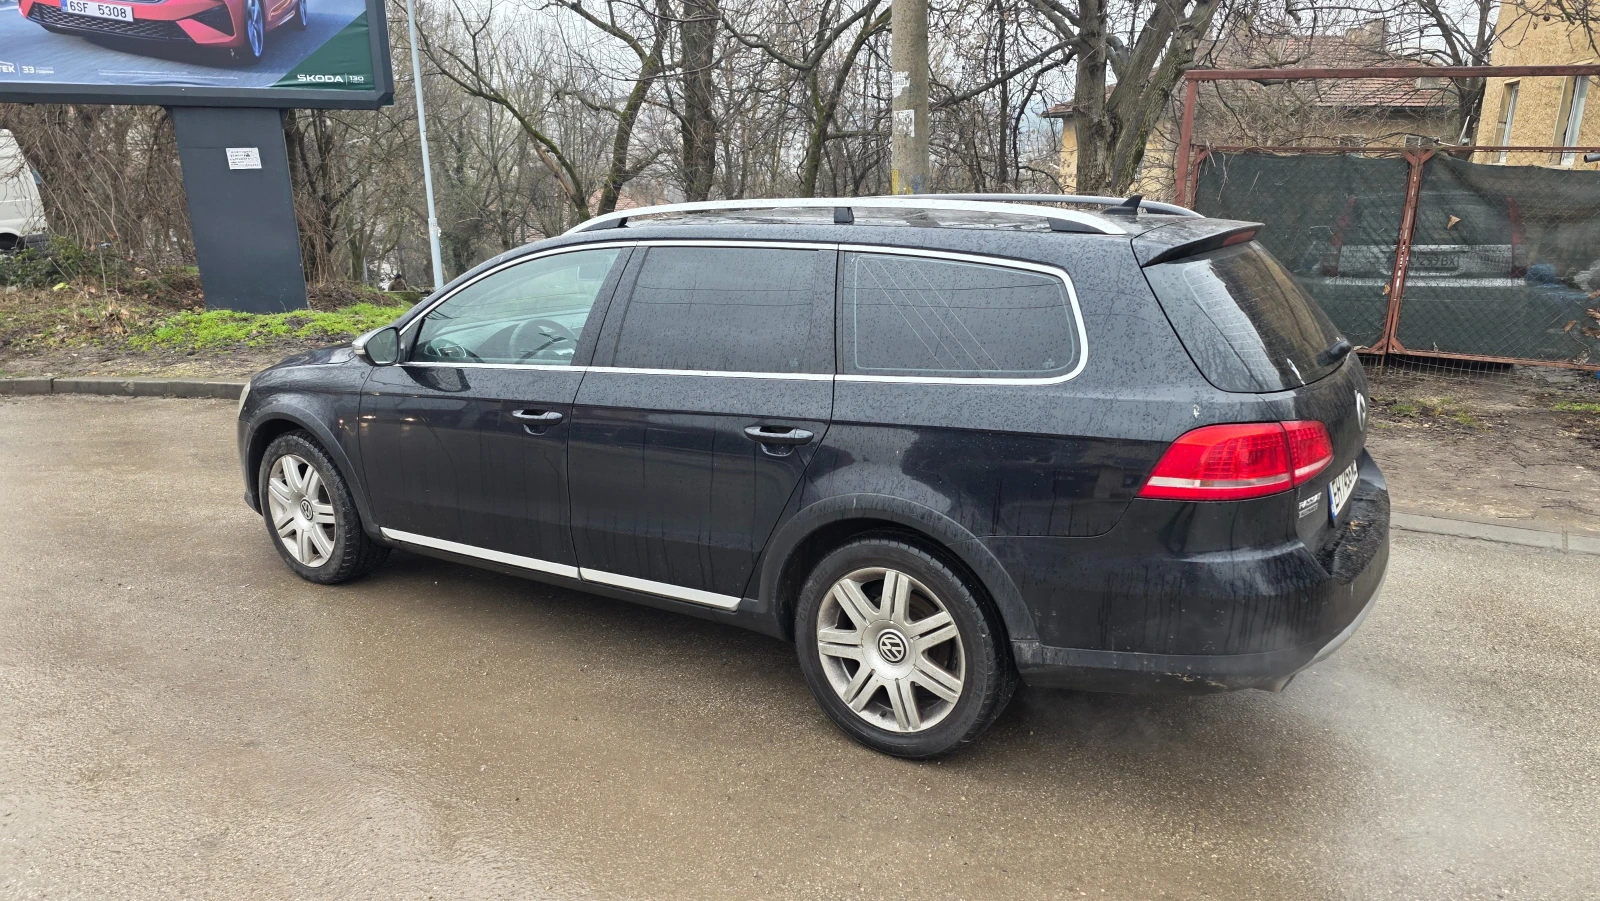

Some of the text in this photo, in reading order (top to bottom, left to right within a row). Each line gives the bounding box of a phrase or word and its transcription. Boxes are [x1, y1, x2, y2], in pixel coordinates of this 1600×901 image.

[70, 1, 127, 18] 6SF 5308
[22, 66, 35, 74] 33
